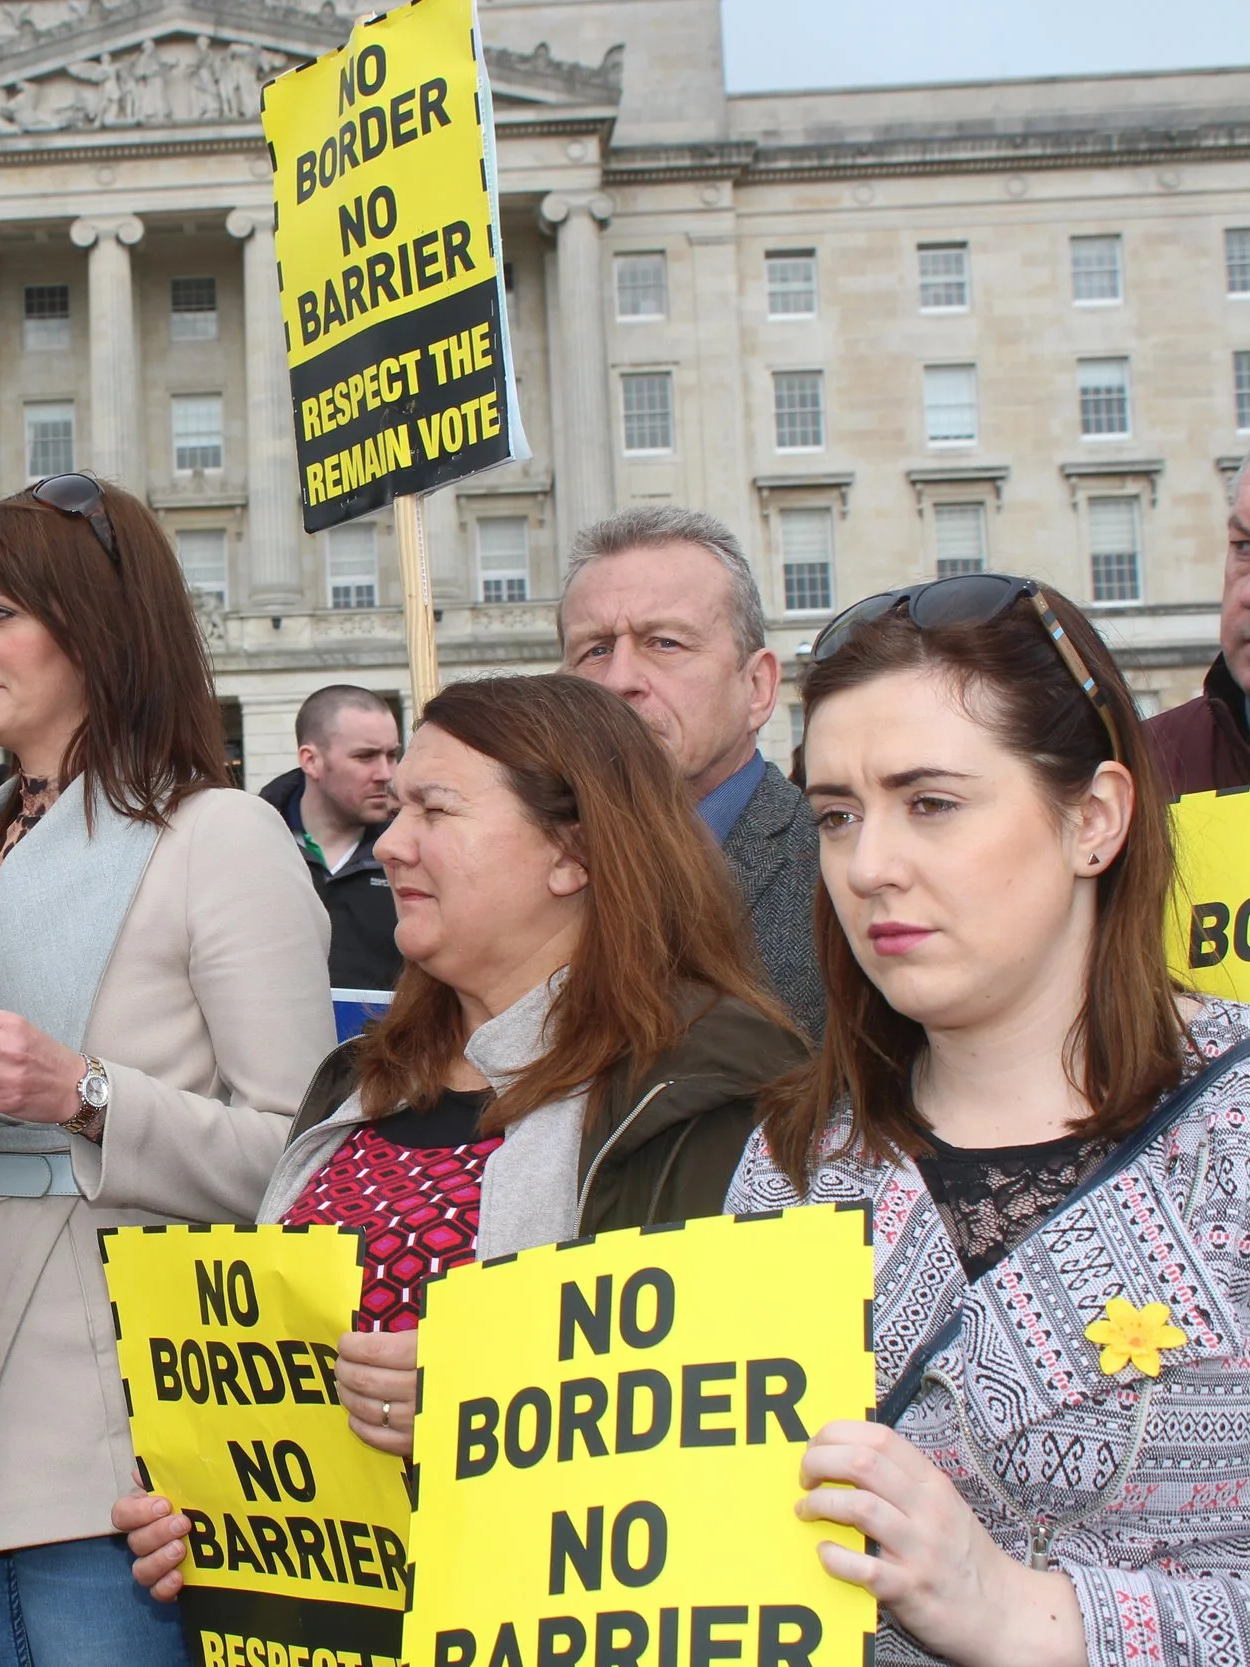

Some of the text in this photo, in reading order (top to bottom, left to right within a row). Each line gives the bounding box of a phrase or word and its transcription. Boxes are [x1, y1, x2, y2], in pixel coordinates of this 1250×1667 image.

[338, 43, 387, 118] NO
[296, 76, 451, 205] BORDER
[338, 184, 398, 257] NO
[298, 219, 476, 346] BARRIER
[301, 321, 493, 442] RESPECT THE
[306, 390, 500, 507] REMAIN VOTE
[194, 1259, 260, 1328] NO
[558, 1266, 676, 1362] NO
[455, 1357, 810, 1481] BORDER
[226, 1439, 317, 1503] NO
[181, 1507, 408, 1591] BARRIER
[548, 1500, 668, 1596] NO
